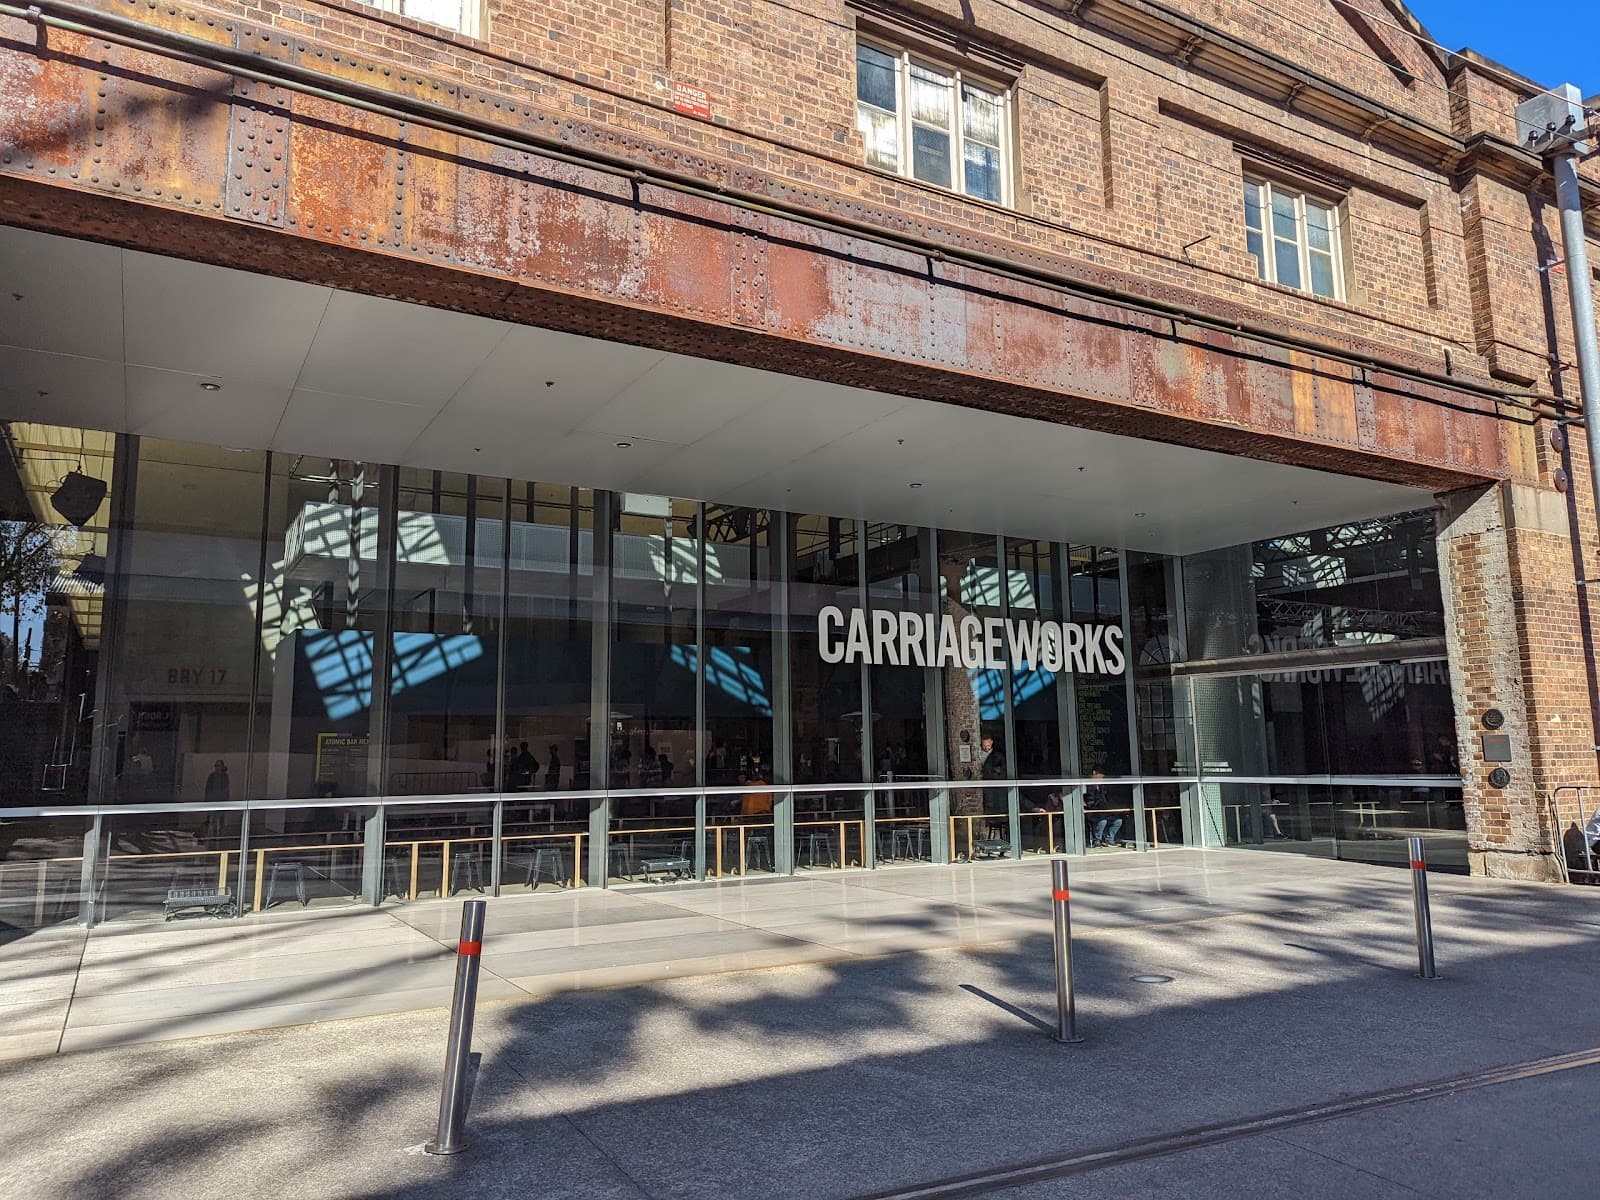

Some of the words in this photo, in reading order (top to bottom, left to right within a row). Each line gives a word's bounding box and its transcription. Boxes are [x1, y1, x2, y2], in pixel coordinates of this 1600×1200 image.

[677, 85, 706, 99] DANGER
[818, 606, 1125, 675] CARRIAGEWORKS
[168, 667, 204, 686] BAY
[209, 668, 227, 686] 17
